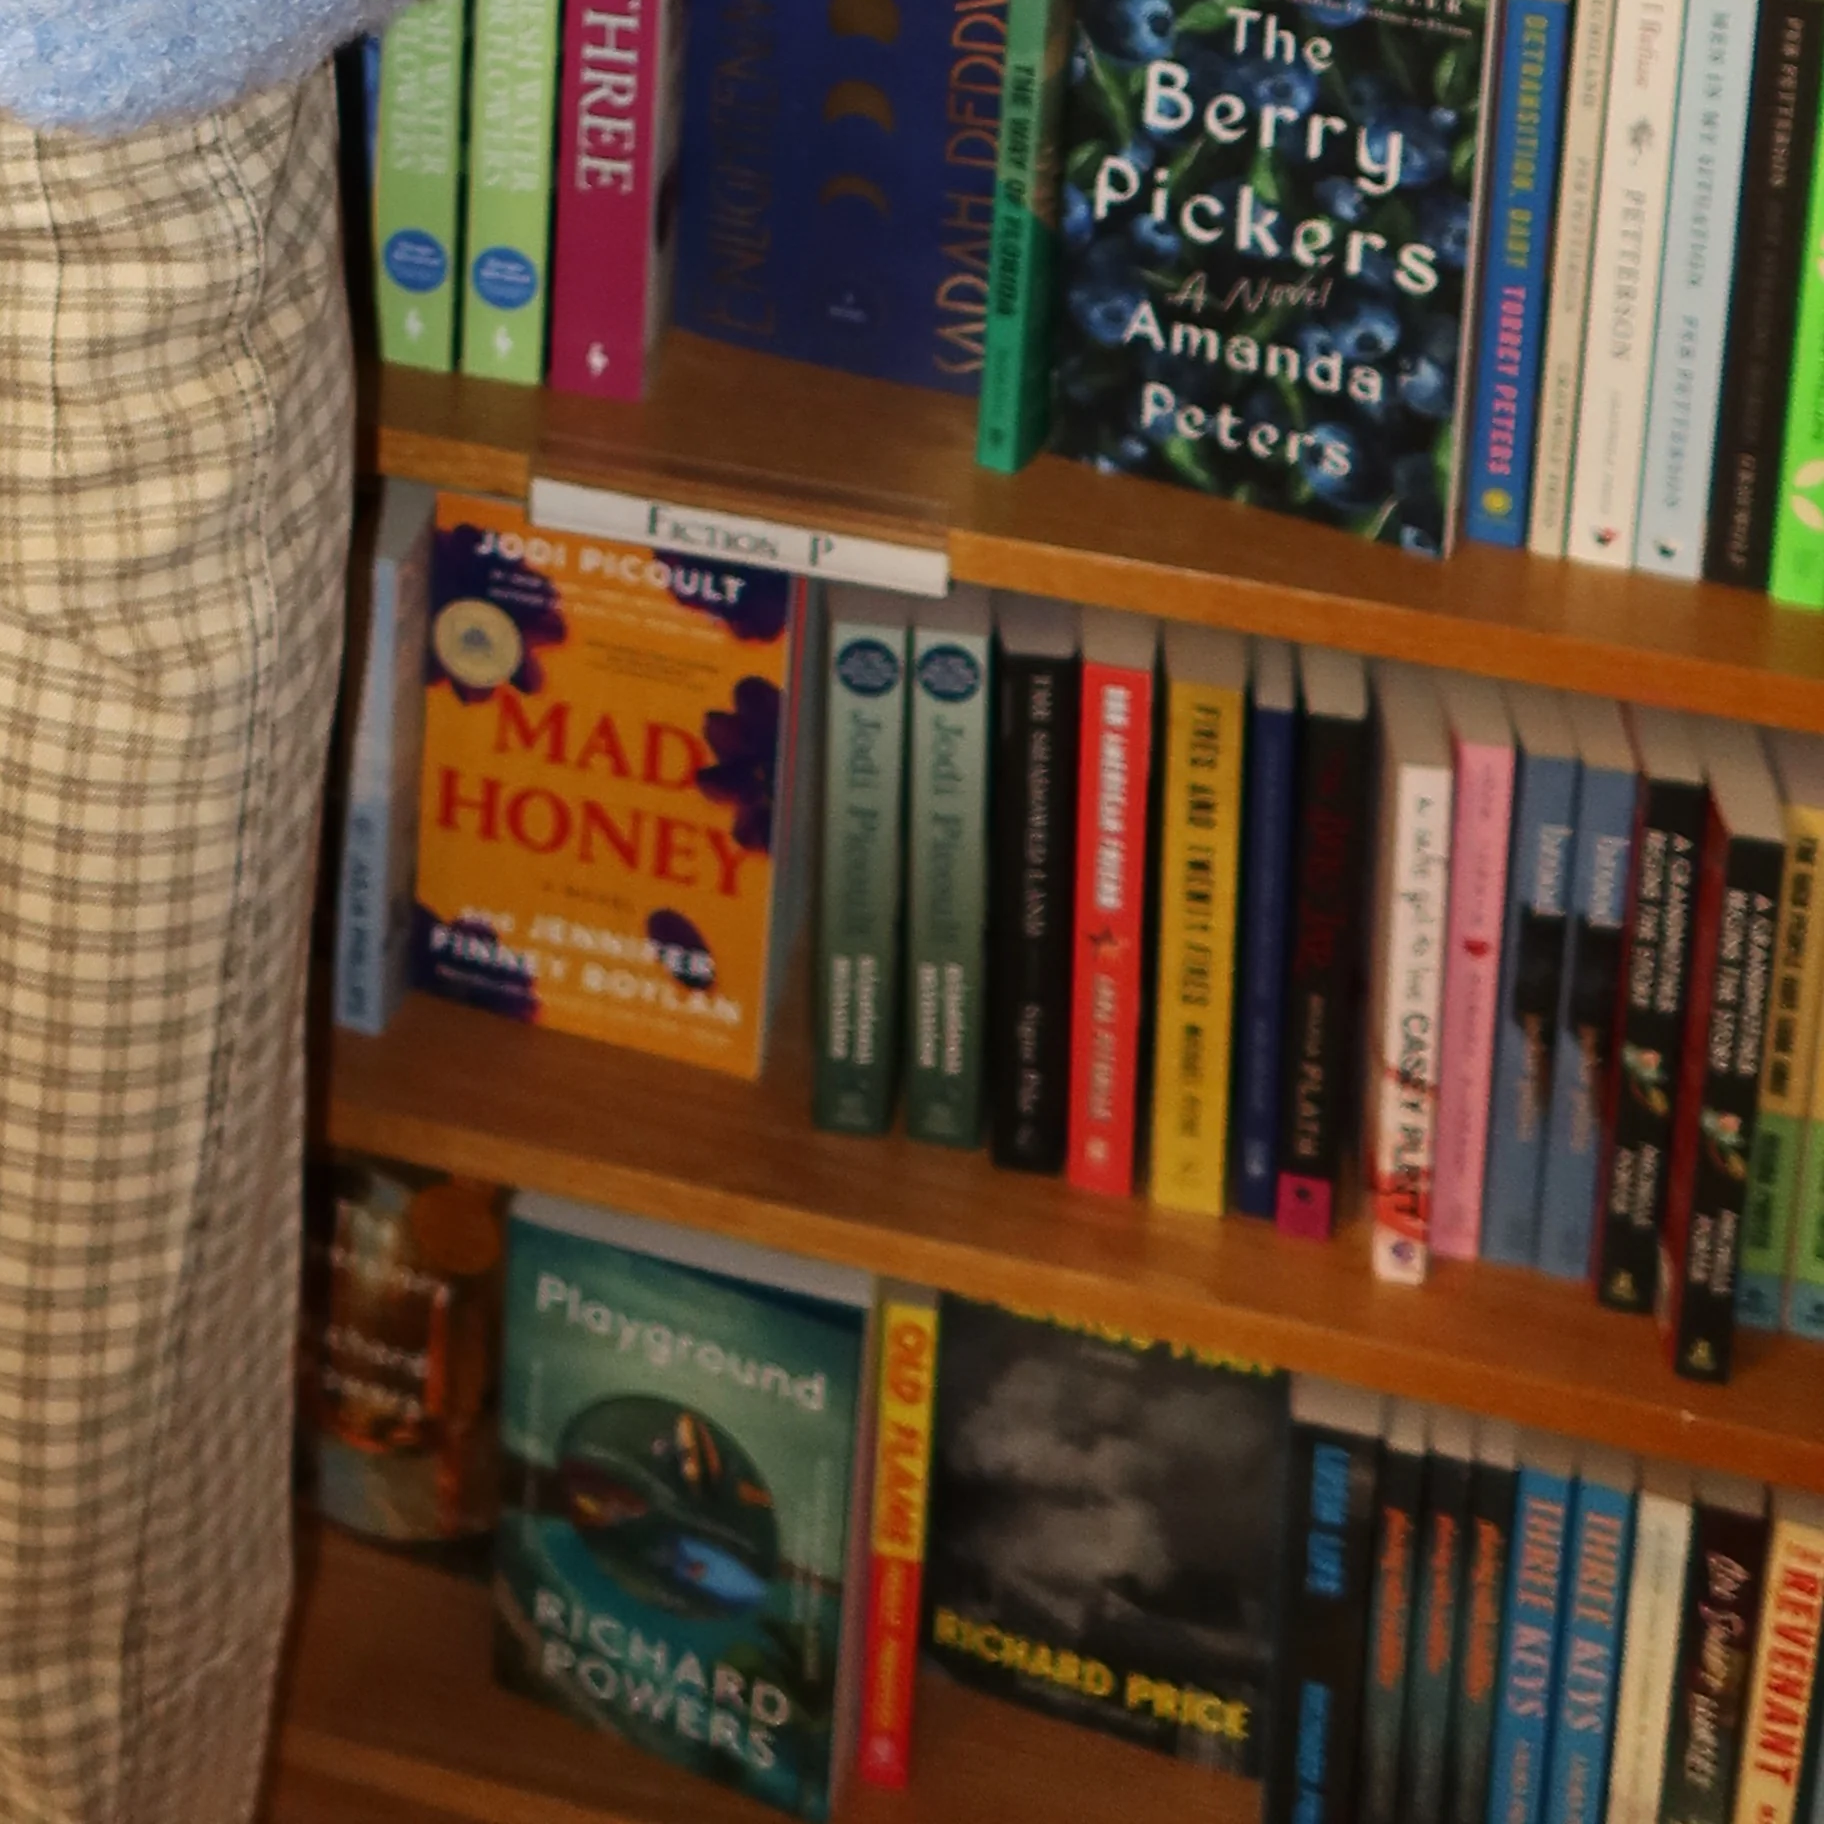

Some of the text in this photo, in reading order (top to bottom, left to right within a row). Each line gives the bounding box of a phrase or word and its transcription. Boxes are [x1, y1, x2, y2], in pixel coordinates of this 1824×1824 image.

[1224, 6, 1334, 72] The
[1144, 59, 1406, 195] Berry
[1093, 157, 1440, 298] Pickers
[1123, 300, 1385, 403] Amanda
[1225, 276, 1334, 314] Novel
[1140, 380, 1353, 482] Peters
[477, 530, 747, 605] JODI PICOULT
[492, 690, 717, 793] MAD
[434, 765, 757, 901] HONEY
[534, 1274, 827, 1412] Playground
[532, 1590, 791, 1729] RICHARD
[539, 1641, 779, 1771] POWERS
[932, 1605, 1252, 1745] RICHARD PRICE
